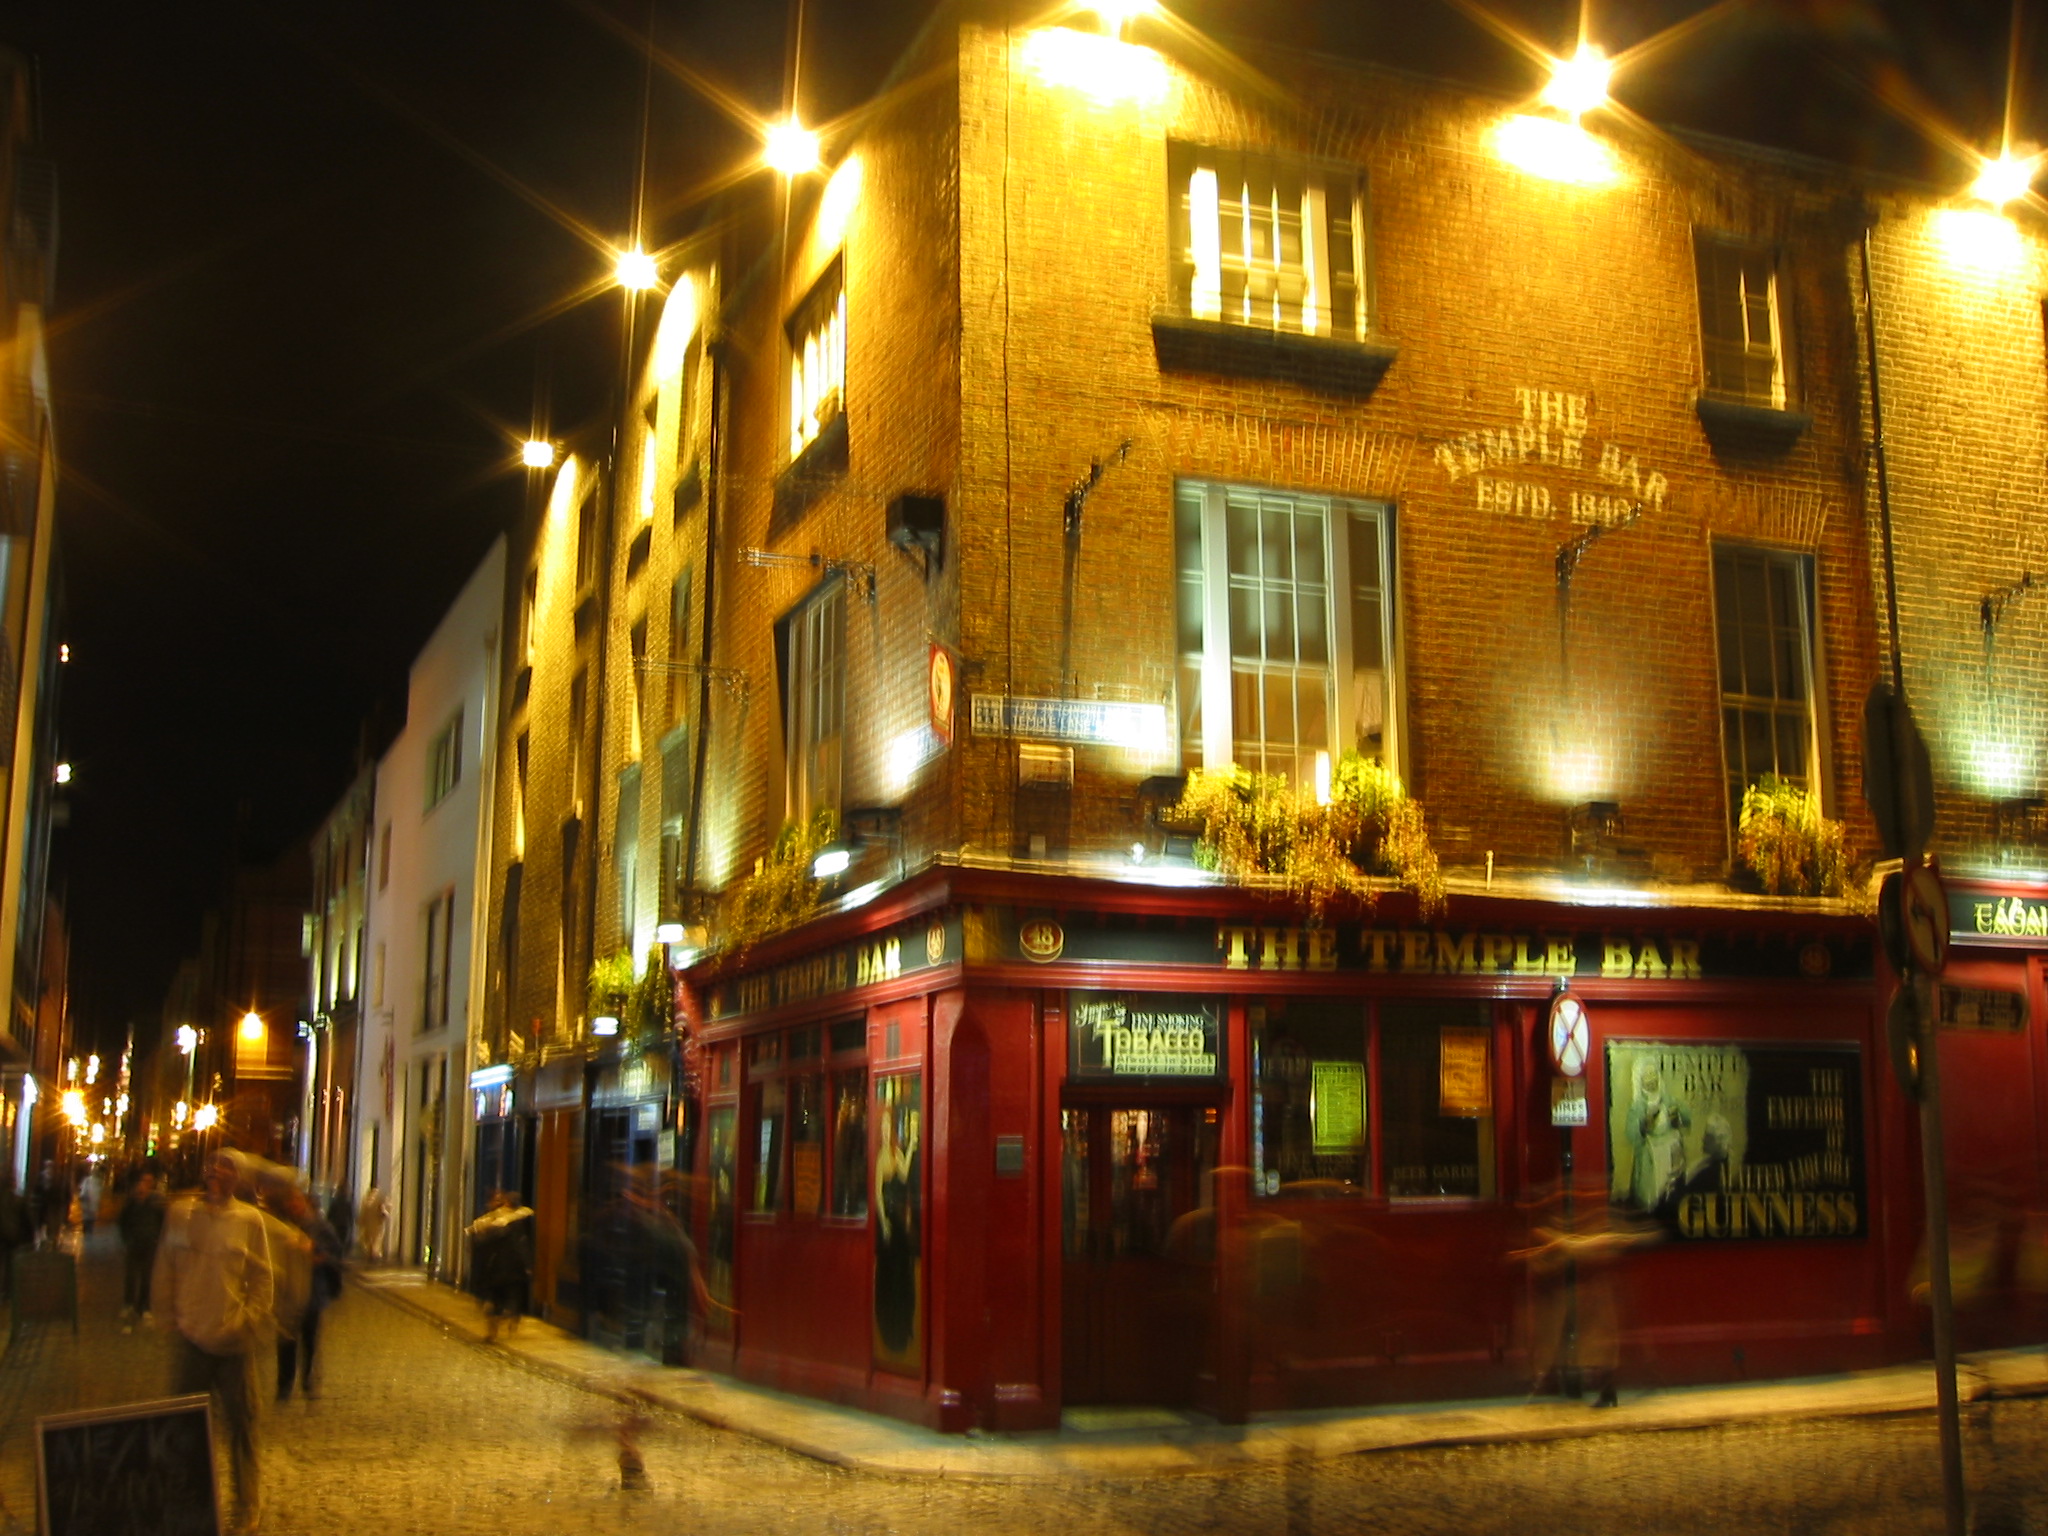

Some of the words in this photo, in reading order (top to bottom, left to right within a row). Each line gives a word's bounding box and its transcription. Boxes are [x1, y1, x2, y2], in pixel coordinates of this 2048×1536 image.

[1515, 386, 1587, 436] THE
[1598, 441, 1668, 512] BAR
[856, 937, 899, 986] BAR
[1218, 926, 1337, 970] THE
[1361, 929, 1577, 977] TEMPLE
[1600, 936, 1701, 979] BAR
[1096, 1018, 1205, 1070] TOBACCO
[1659, 1053, 1747, 1074] TEMPLE
[1684, 1073, 1723, 1094] BAR
[1677, 1191, 1858, 1239] GUINNESS
